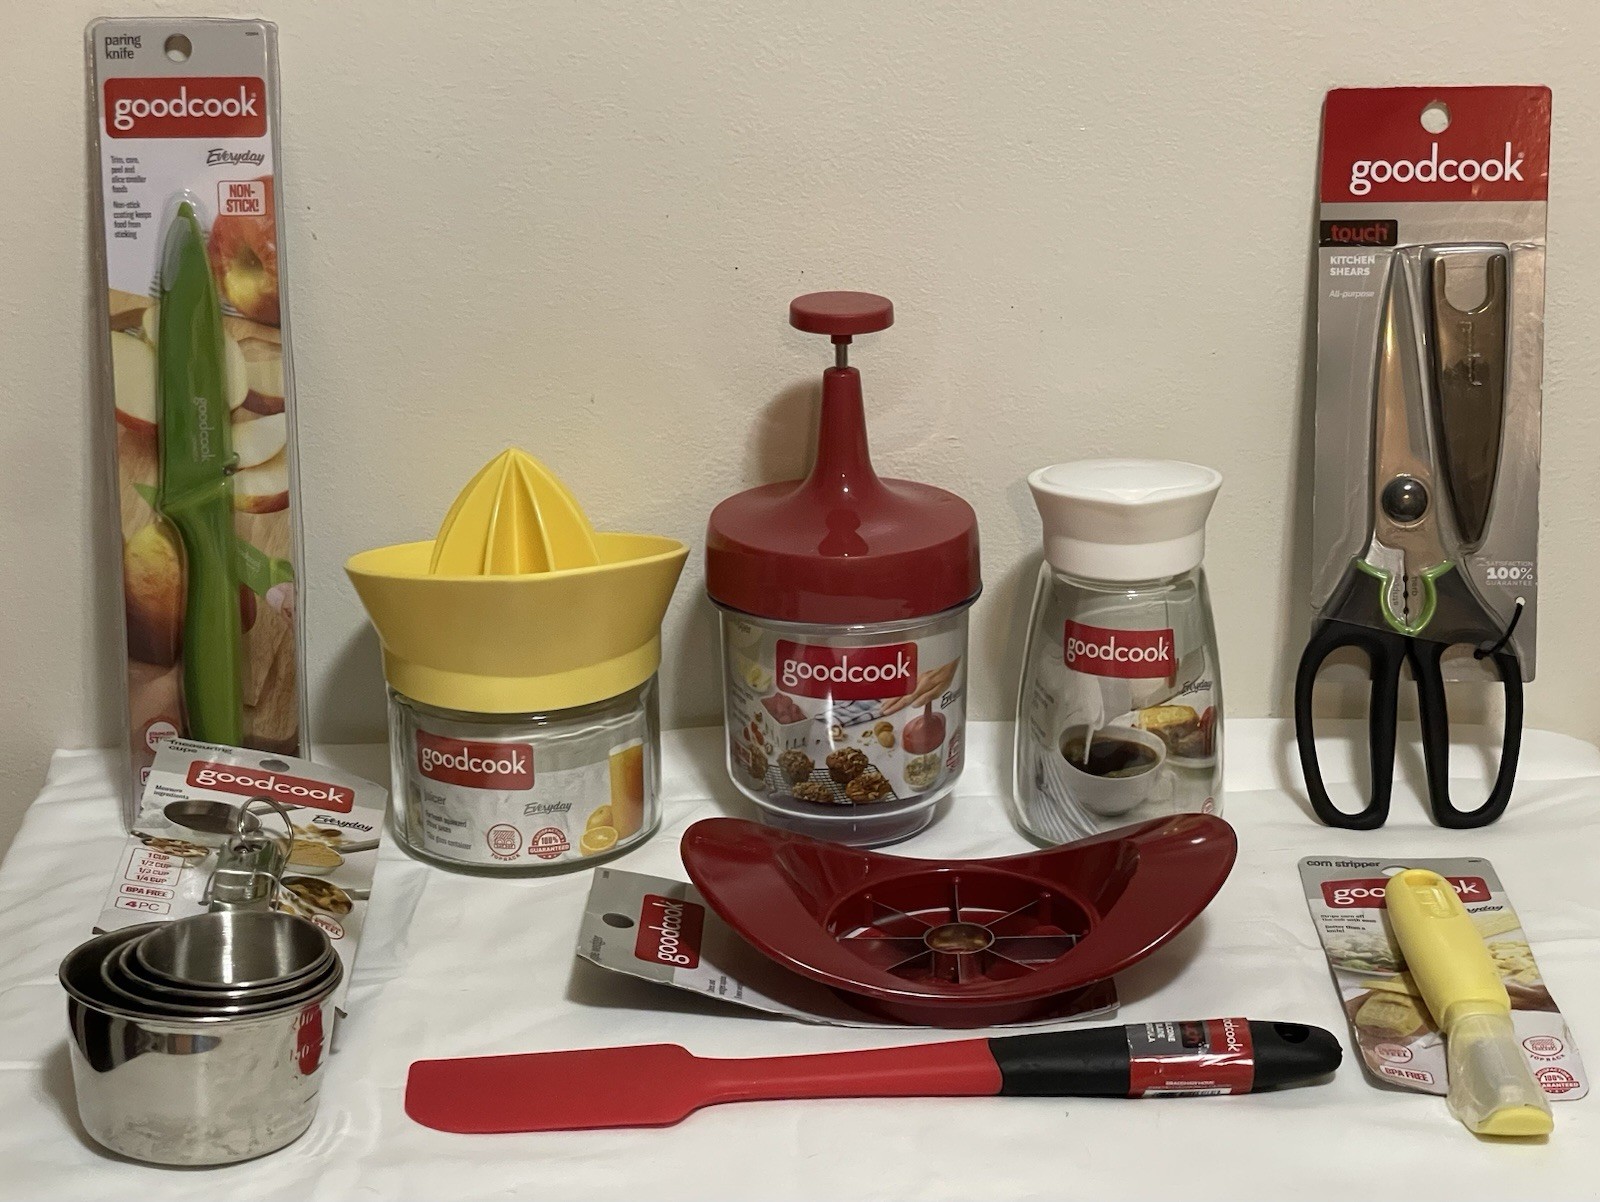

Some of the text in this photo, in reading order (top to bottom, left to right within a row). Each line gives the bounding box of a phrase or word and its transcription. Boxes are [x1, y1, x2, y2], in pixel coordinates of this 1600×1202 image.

[105, 34, 142, 48] paring
[105, 47, 135, 60] knife
[114, 86, 258, 131] goodcook
[206, 148, 265, 167] Everyday
[1349, 142, 1524, 195] goodcook
[229, 183, 256, 197] NON-
[226, 199, 260, 213] STICK!
[1330, 223, 1388, 241] touch
[1330, 256, 1376, 265] KITCHEN
[1330, 267, 1371, 276] SHEARS
[1329, 290, 1375, 298] All-purpose
[1486, 566, 1533, 580] 100%
[1067, 636, 1169, 663] goodcook
[782, 651, 911, 687] goodcook
[421, 747, 527, 774] goodcook
[196, 768, 345, 804] goodcook
[523, 801, 572, 816] Everyday
[312, 814, 373, 832] Everyday
[529, 844, 570, 853] GUARANTEED
[1306, 859, 1380, 869] corn stripper
[125, 886, 144, 894] BPA
[648, 901, 690, 965] goodcook
